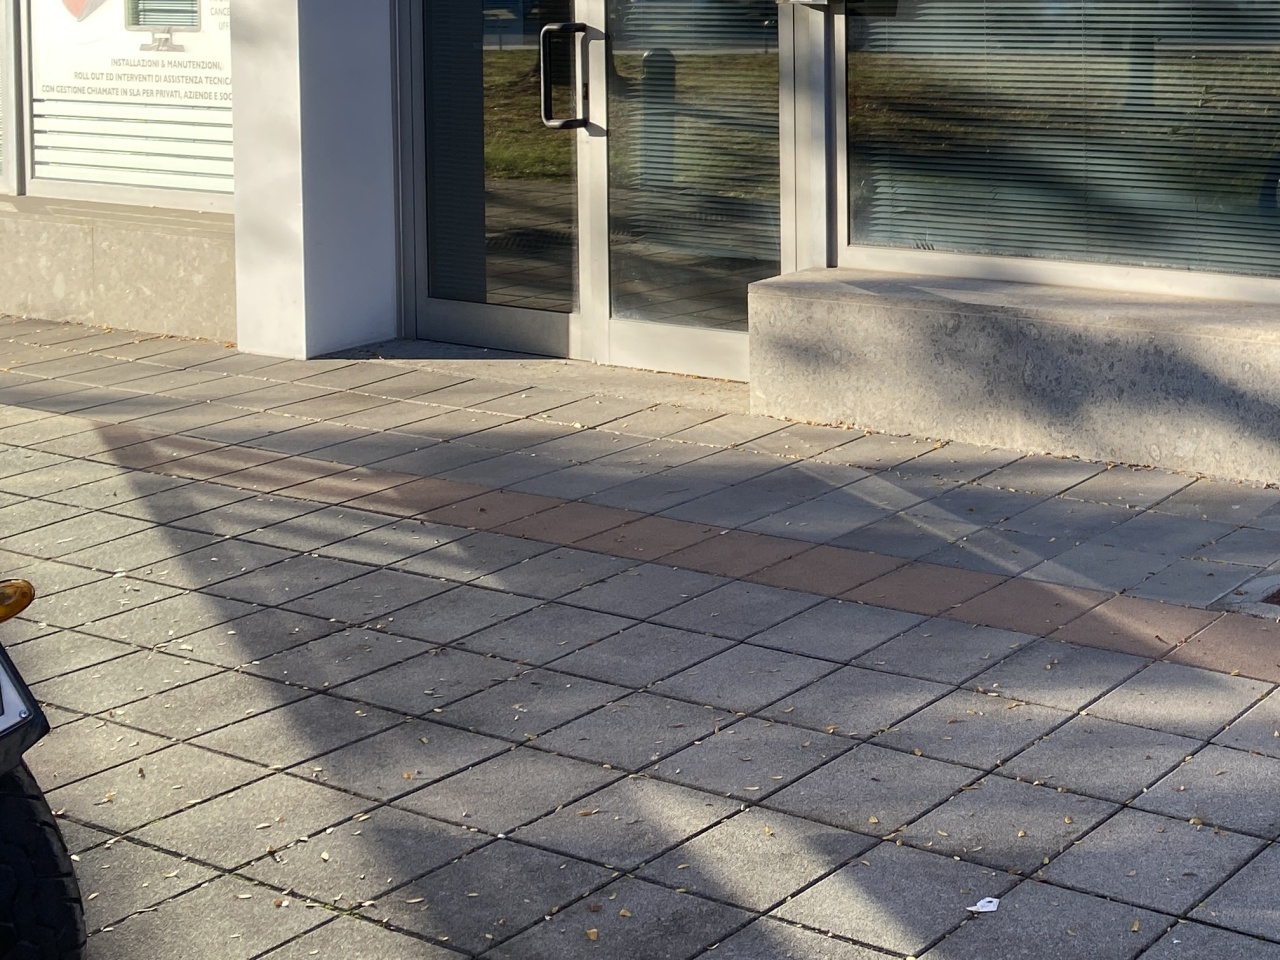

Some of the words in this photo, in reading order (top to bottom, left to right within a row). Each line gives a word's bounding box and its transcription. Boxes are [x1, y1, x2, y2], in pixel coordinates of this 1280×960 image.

[210, 7, 230, 16] CANCE
[218, 22, 229, 31] UFF
[110, 58, 160, 69] INSTALLAZIONI
[161, 59, 166, 69] &
[74, 71, 90, 81] ROLL
[91, 72, 105, 81] OUT
[106, 73, 114, 81] ED
[115, 73, 154, 83] INTERVENTI
[155, 74, 162, 82] DI
[163, 74, 203, 85] ASSISTENZA
[42, 85, 55, 93] CON
[56, 85, 86, 95] GESTIONE
[87, 86, 119, 96] CHIAMATE
[121, 88, 128, 97] IN
[129, 88, 141, 97] SLA
[142, 88, 155, 98] PER
[155, 89, 183, 100] PRIVATI,
[184, 90, 213, 101] AZIENDE
[214, 91, 219, 101] E
[220, 92, 232, 102] SOC
